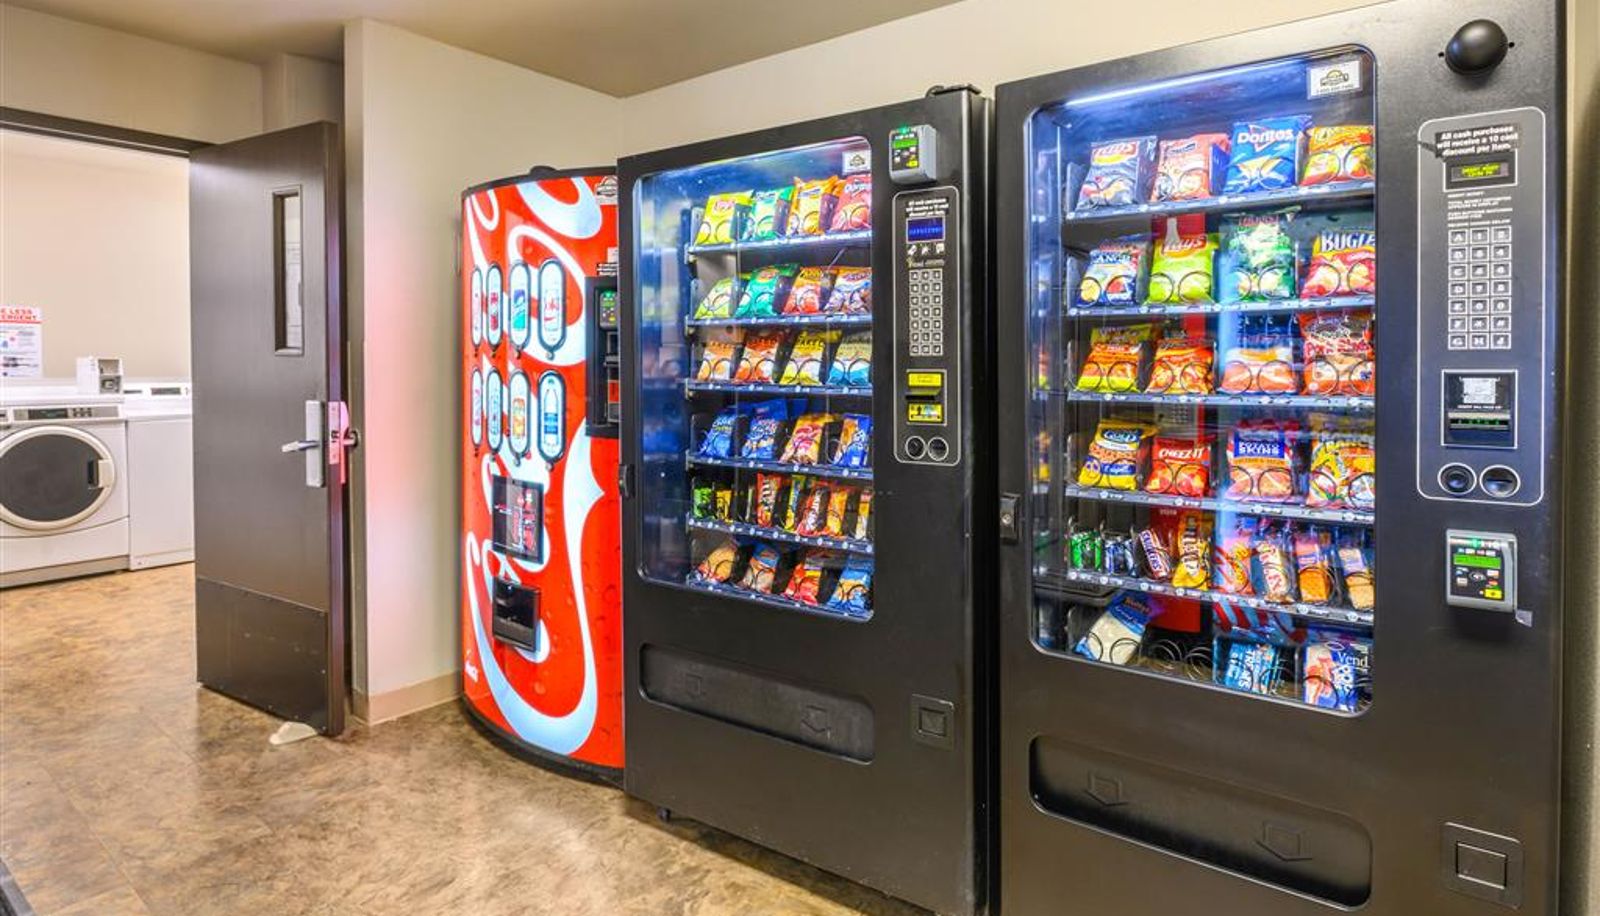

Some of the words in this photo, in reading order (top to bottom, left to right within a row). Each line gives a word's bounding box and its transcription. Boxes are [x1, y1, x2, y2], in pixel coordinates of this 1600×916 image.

[1237, 128, 1295, 144] Doritos
[1473, 125, 1514, 138] purchases
[1158, 446, 1204, 460] CHEEZ-IT
